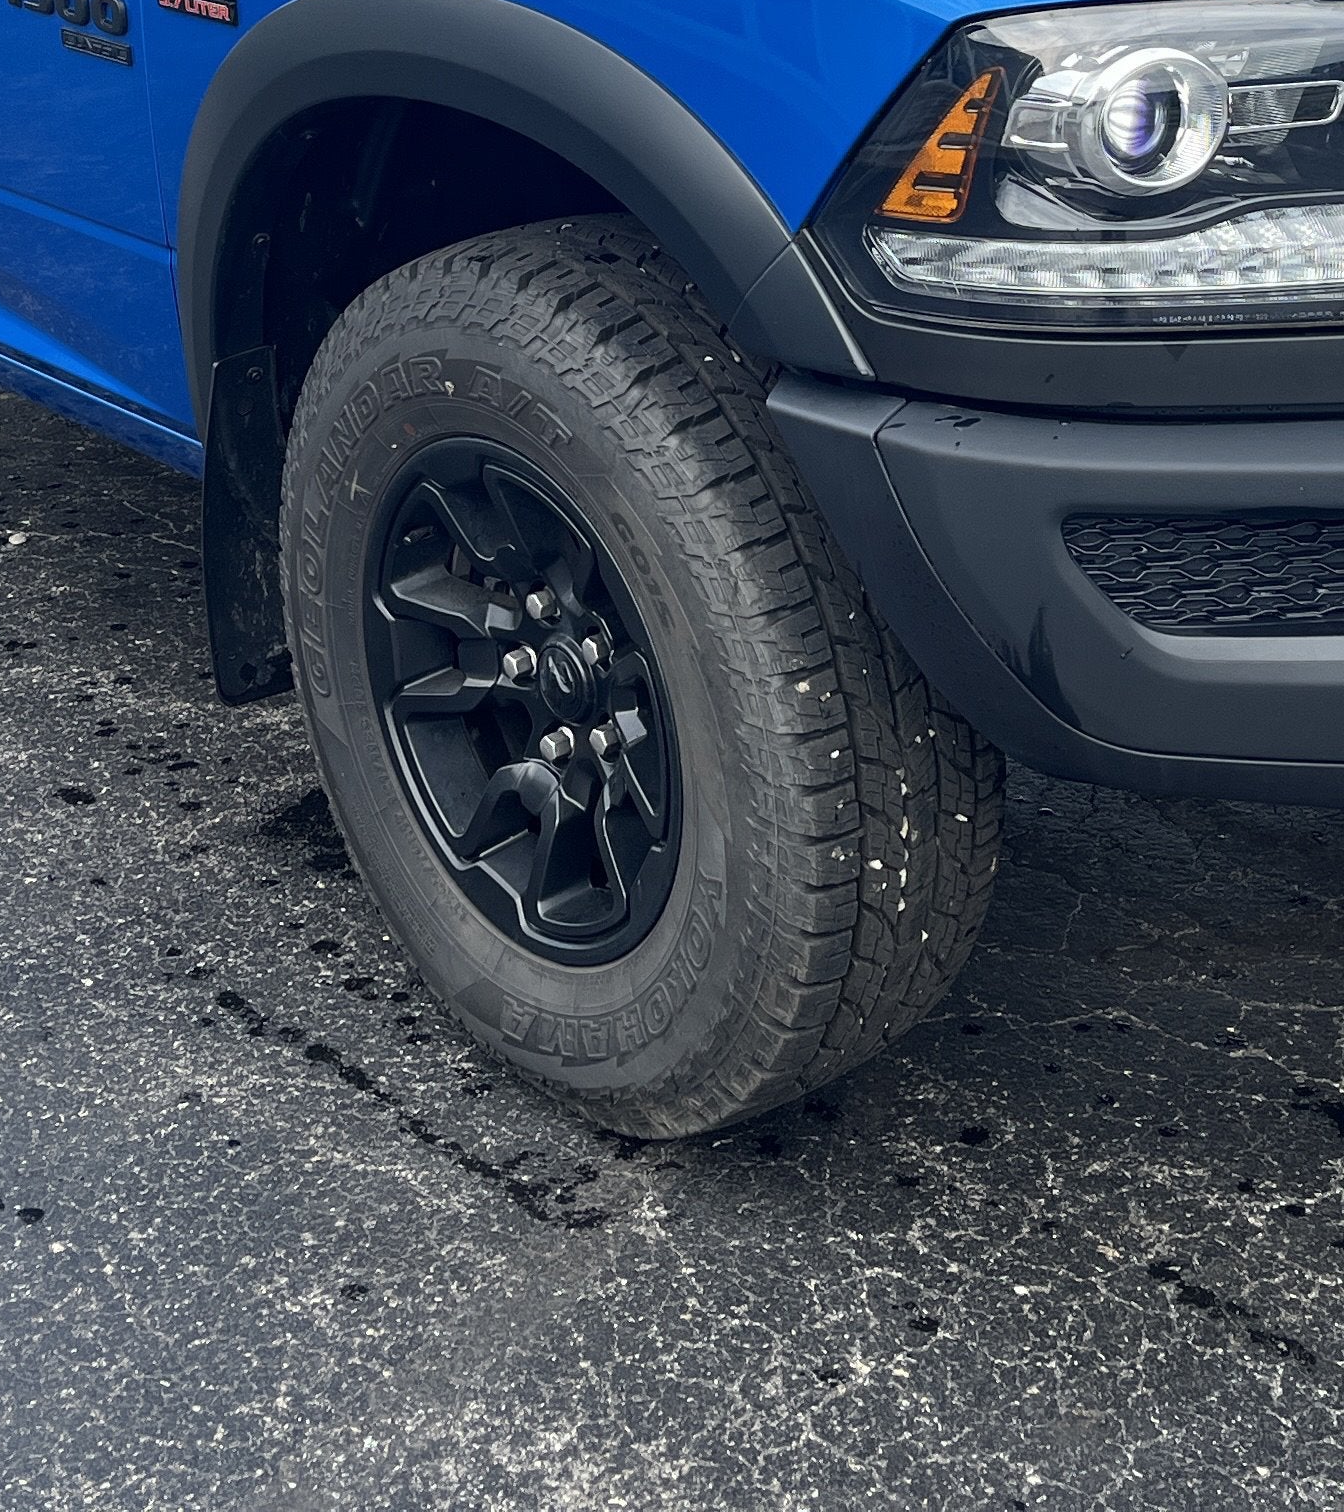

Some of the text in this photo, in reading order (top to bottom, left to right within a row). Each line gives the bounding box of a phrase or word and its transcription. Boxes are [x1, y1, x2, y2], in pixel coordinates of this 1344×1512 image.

[299, 355, 448, 698] GEOLANDAR
[467, 364, 574, 445] A/T
[498, 867, 724, 1058] YOKOHAMA
